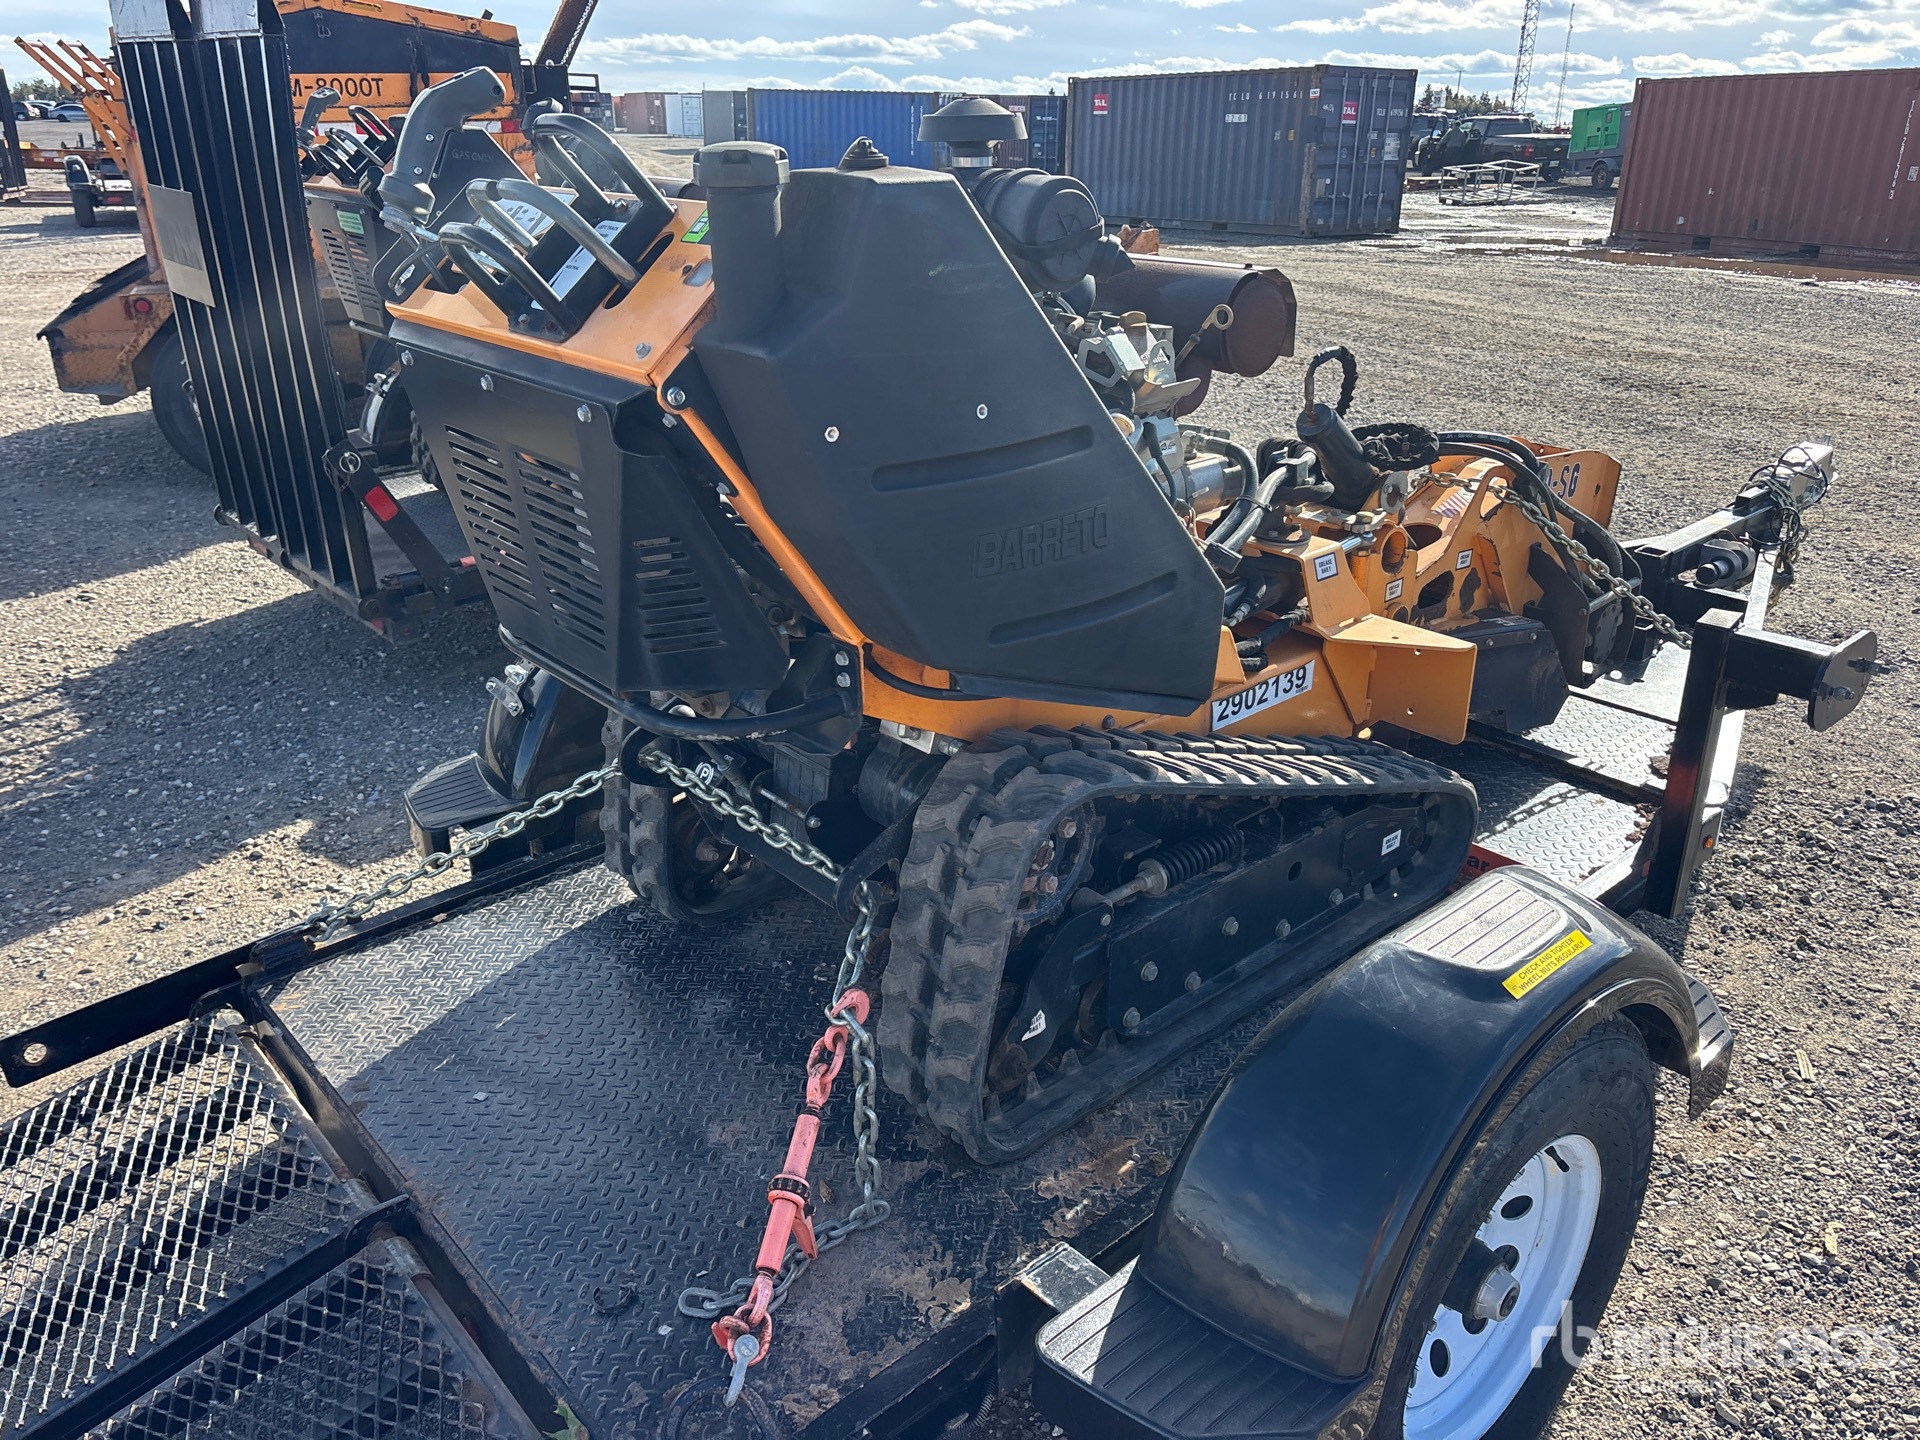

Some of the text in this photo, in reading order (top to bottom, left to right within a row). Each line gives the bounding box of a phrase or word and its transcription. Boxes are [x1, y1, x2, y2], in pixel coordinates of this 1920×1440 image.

[1093, 99, 1108, 107] TAL
[1342, 106, 1357, 116] TAL
[976, 503, 1109, 579] BARRETO
[1216, 665, 1308, 723] 2902139
[1518, 940, 1585, 991] WHEEL NUTS REGULARLY
[1519, 937, 1575, 980] CHECK AND TIGHTEN
